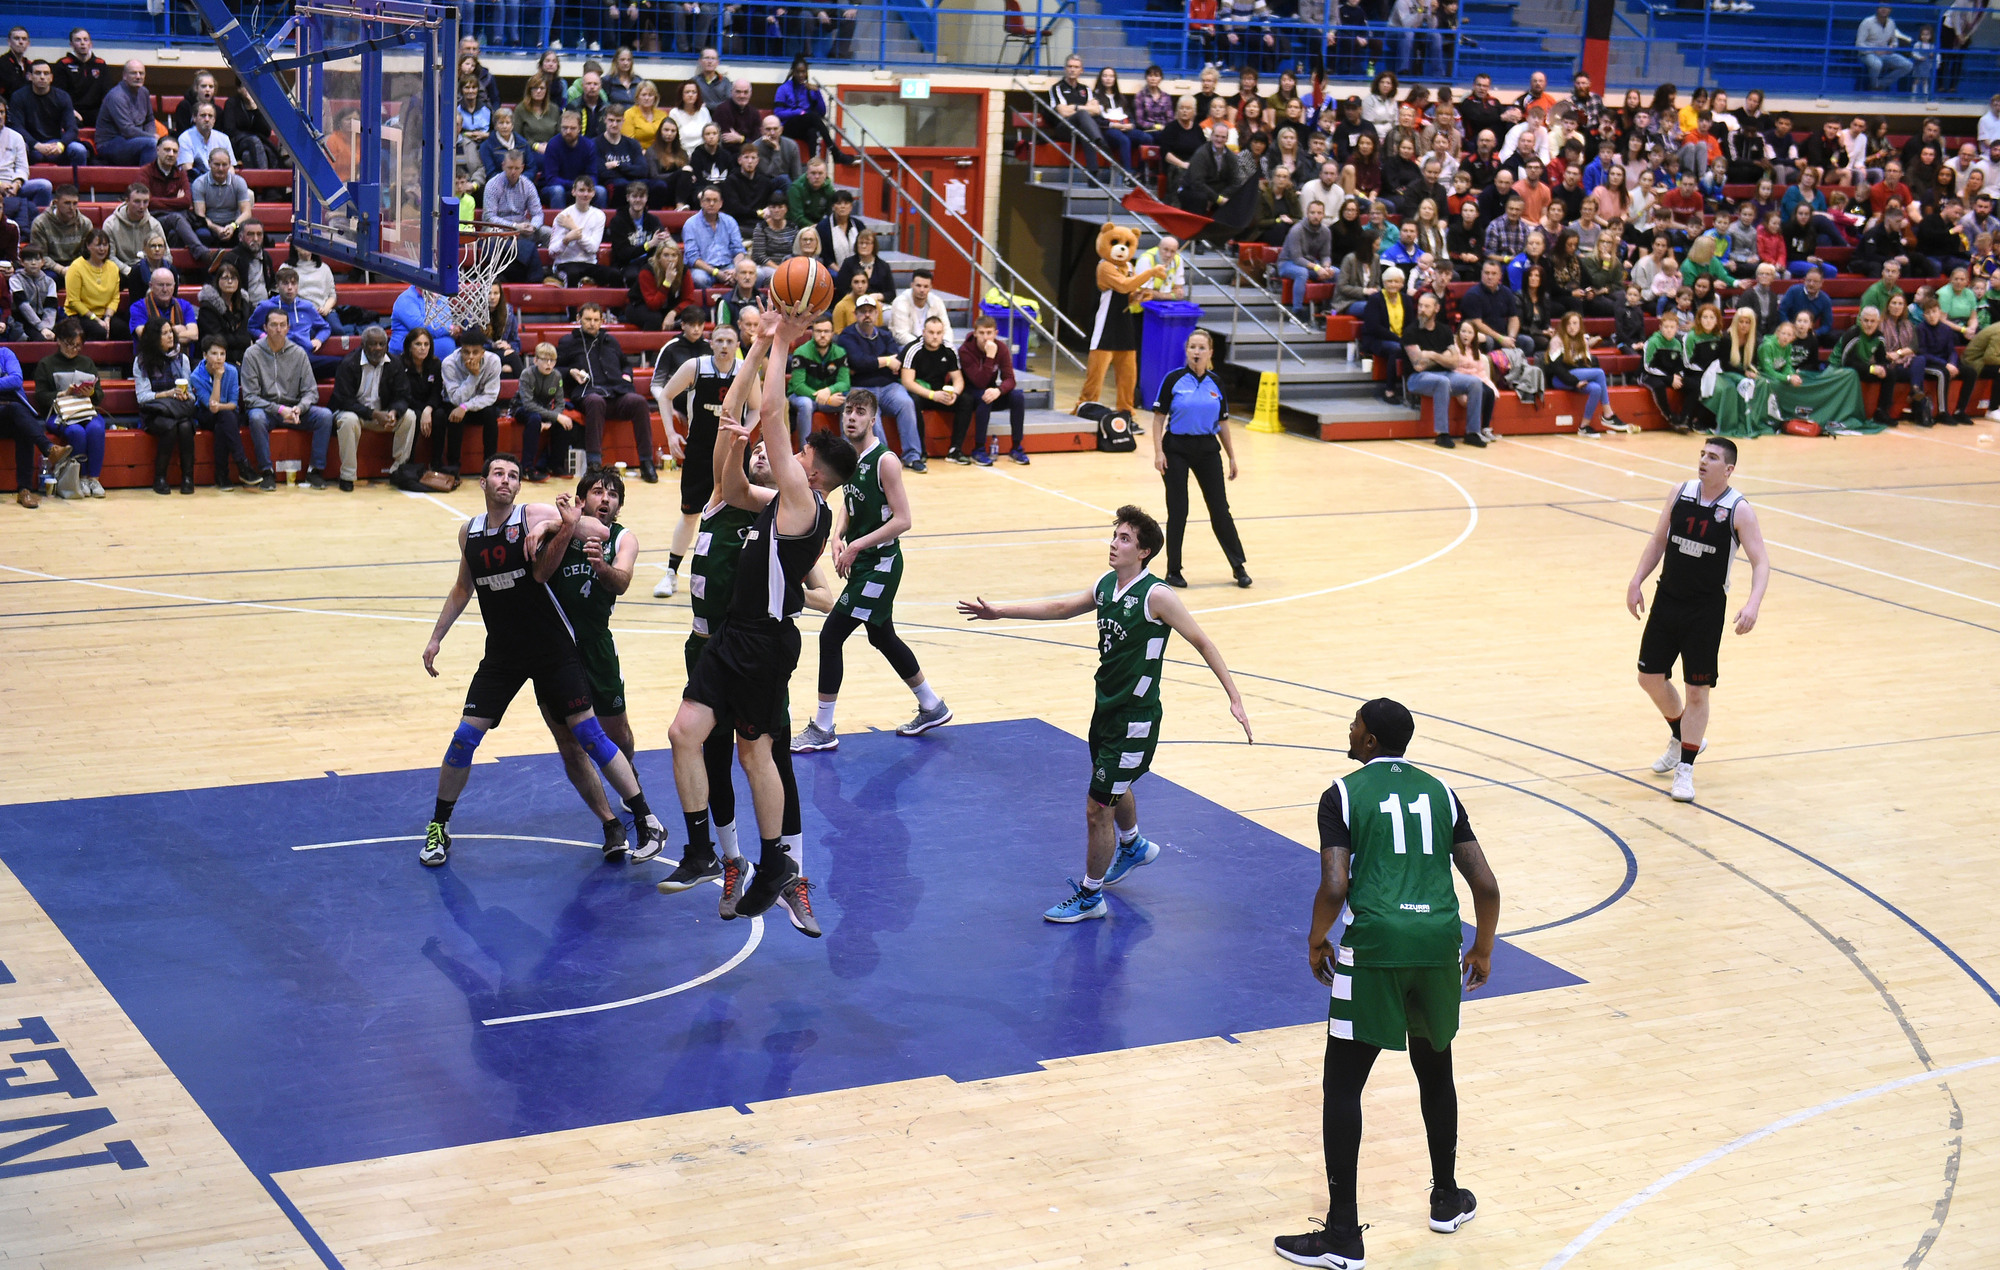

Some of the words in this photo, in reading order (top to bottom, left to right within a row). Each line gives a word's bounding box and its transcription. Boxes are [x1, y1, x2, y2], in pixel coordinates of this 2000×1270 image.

[843, 483, 866, 502] ELTICS
[1686, 516, 1709, 538] 11
[480, 544, 507, 569] 19
[563, 563, 600, 580] CELTI
[579, 579, 592, 599] 4
[1097, 618, 1128, 641] ELTICS
[1103, 633, 1112, 654] 5
[567, 695, 590, 710] BBC
[1379, 793, 1434, 855] 11
